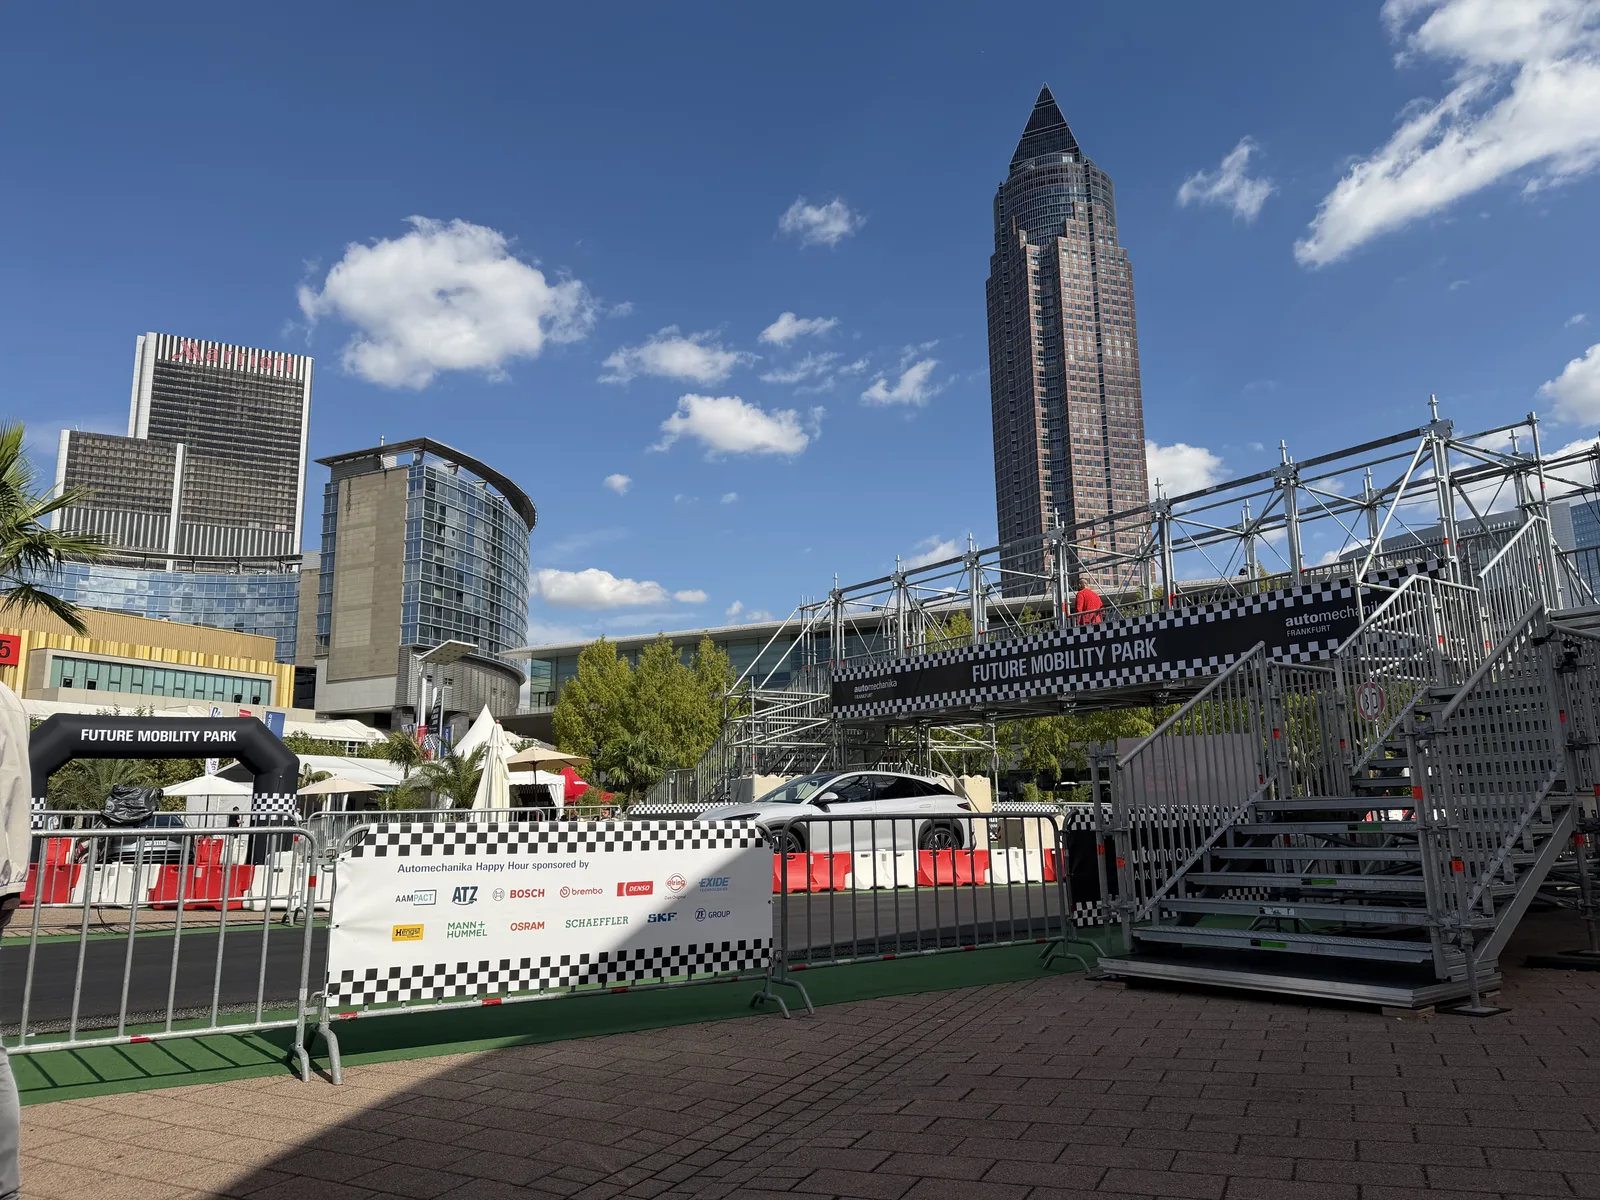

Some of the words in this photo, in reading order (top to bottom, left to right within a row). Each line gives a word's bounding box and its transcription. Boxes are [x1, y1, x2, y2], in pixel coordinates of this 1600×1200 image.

[172, 340, 293, 374] Marriott
[1287, 624, 1331, 637] FRANKFURT
[973, 658, 1027, 682] FUTURE
[1031, 646, 1106, 674] MOBILITY
[1111, 637, 1157, 663] PARK
[853, 680, 897, 692] automechanika
[81, 729, 134, 742] FUTURE
[138, 730, 200, 742] MOBILITY
[203, 730, 237, 742] PARK
[397, 863, 473, 873] Automechanika
[476, 861, 505, 872] Happy
[508, 861, 529, 871] Hour
[532, 860, 576, 870] sponsored
[579, 860, 590, 870] by
[700, 876, 730, 887] EXIDE
[452, 886, 478, 902] ATZ
[510, 888, 545, 898] BOSCH
[572, 887, 603, 896] brembo
[395, 893, 433, 903] AAMPACT
[648, 912, 677, 923] SKF
[696, 910, 705, 920] ZF
[708, 910, 730, 918] GROUP
[447, 921, 485, 930] MANN+
[510, 921, 545, 931] OSRAM
[565, 916, 629, 928] SCHAEFFLER
[395, 927, 420, 937] Hengst
[447, 929, 487, 938] HUMMEL
